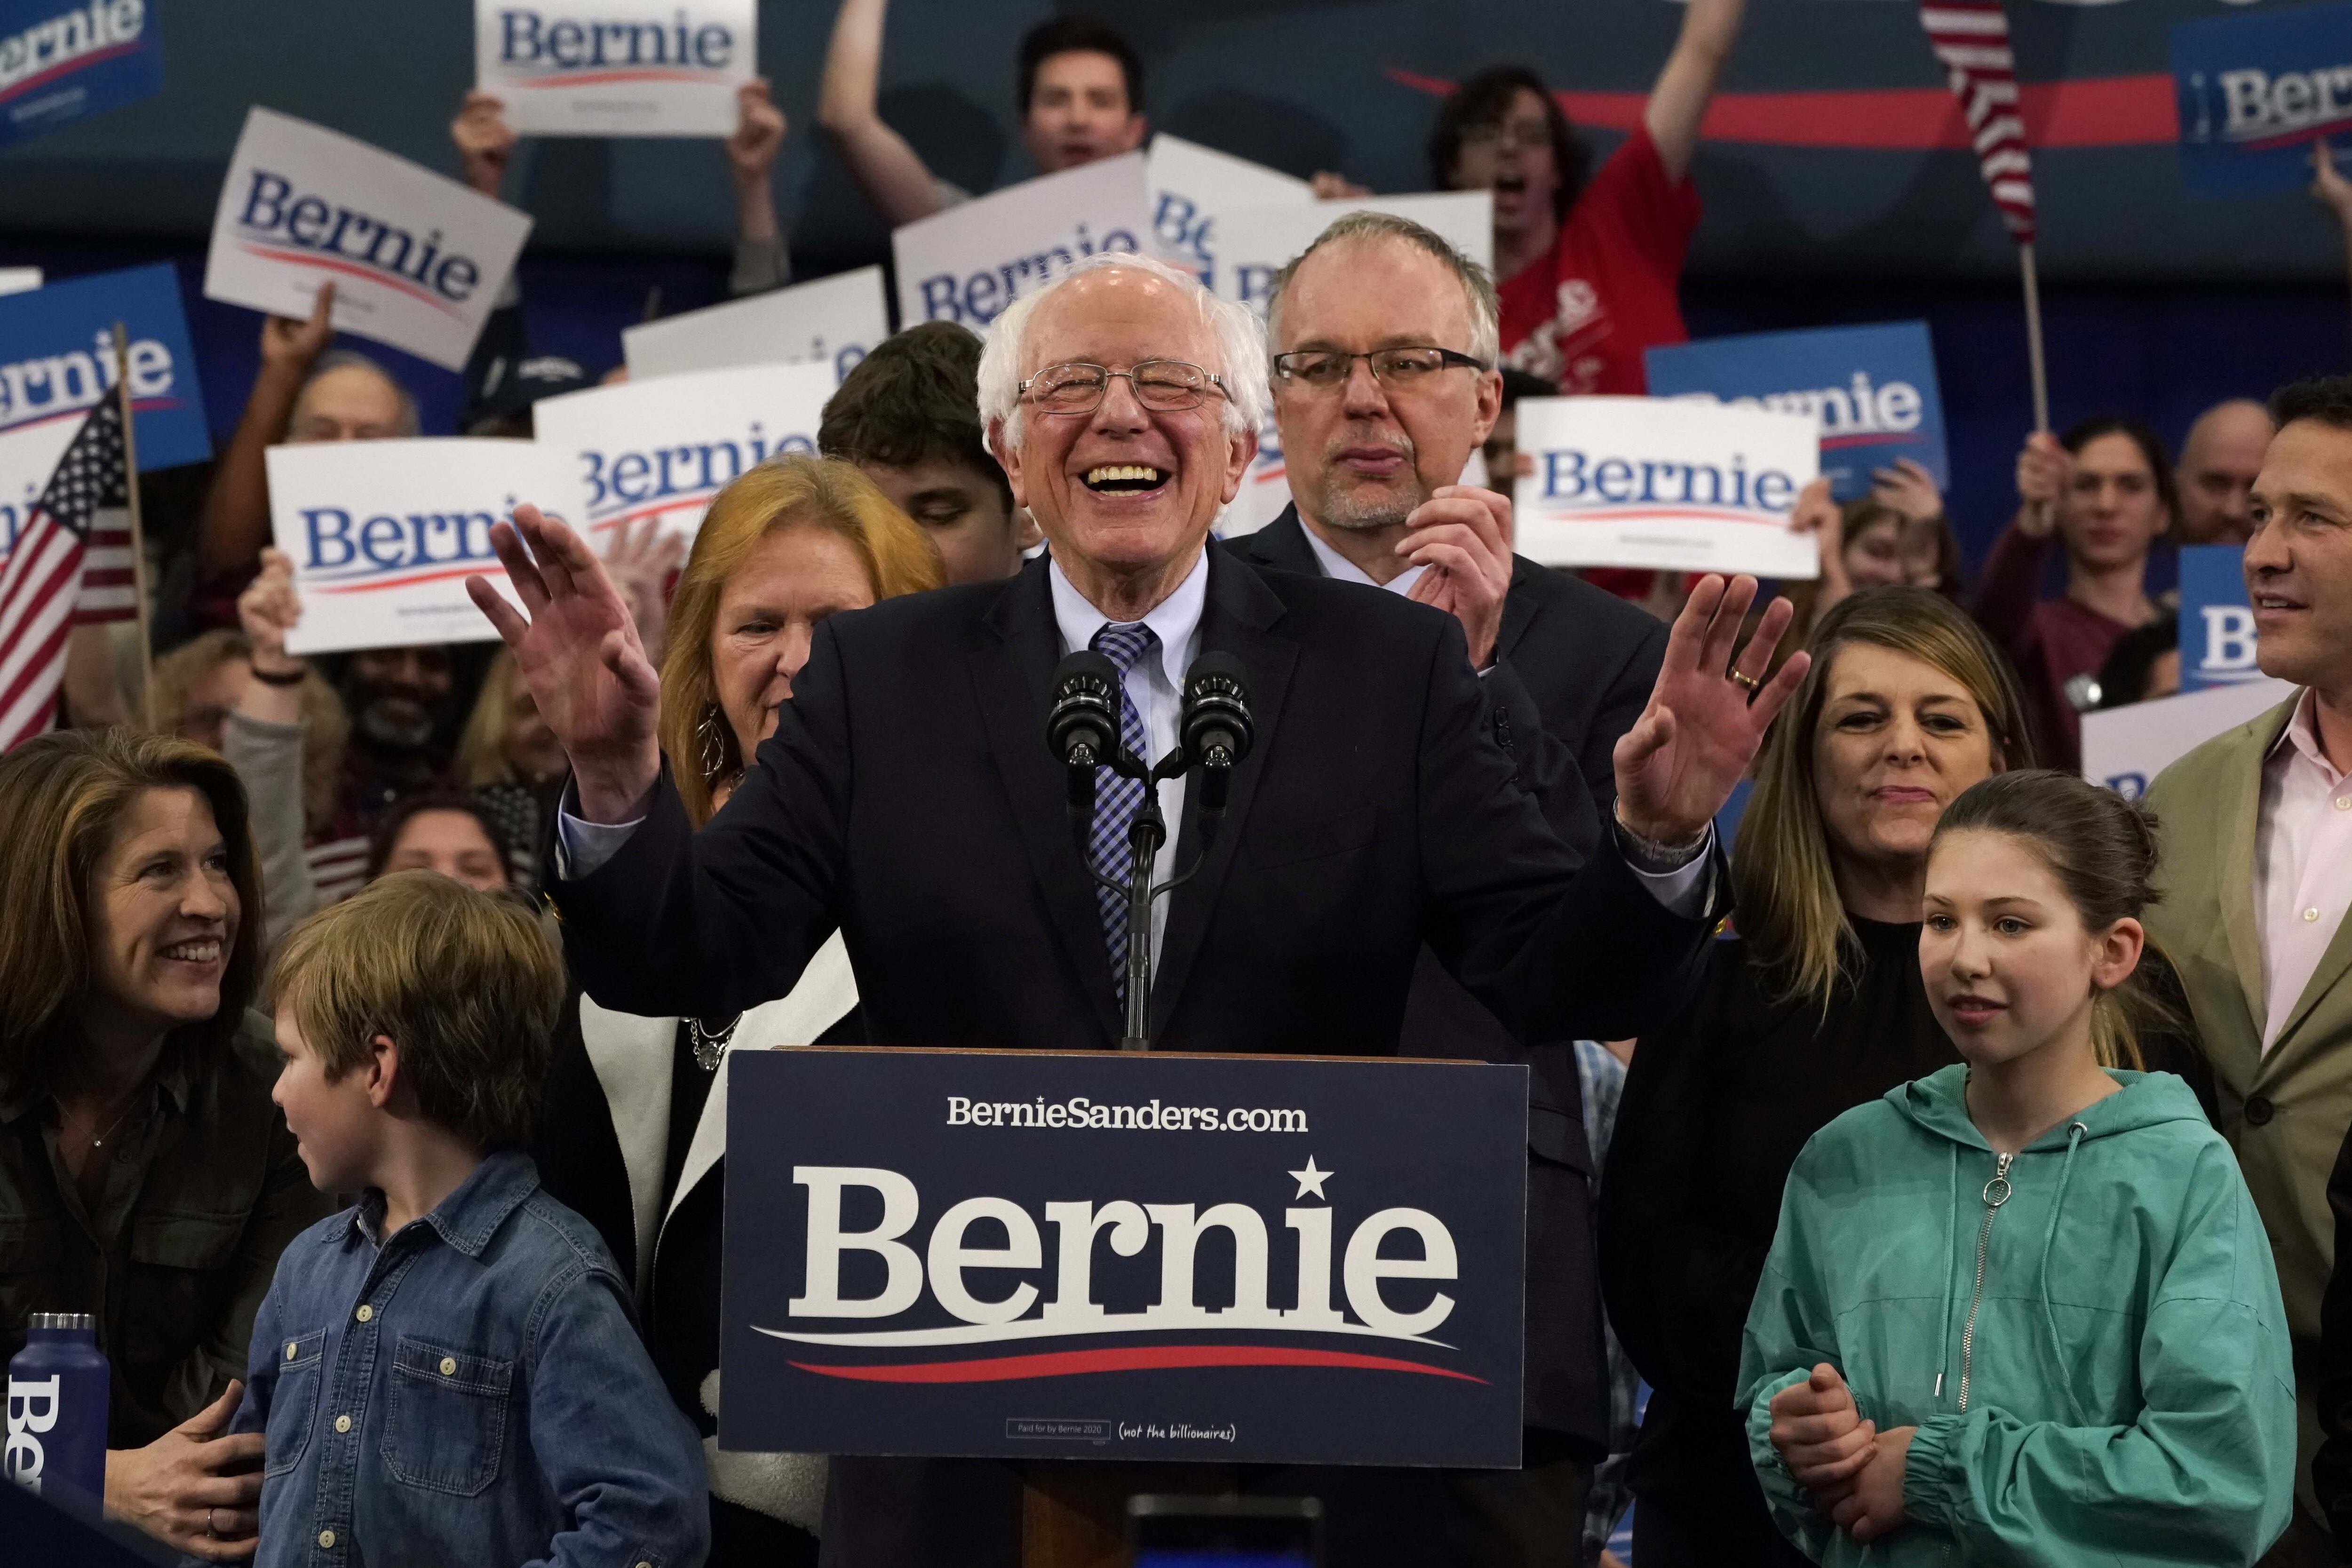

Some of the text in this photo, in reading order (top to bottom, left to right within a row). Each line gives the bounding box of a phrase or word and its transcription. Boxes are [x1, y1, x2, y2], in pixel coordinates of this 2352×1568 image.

[500, 9, 734, 69] Bernie
[239, 167, 480, 302] Bernie
[0, 330, 174, 418] rnie
[1542, 447, 1796, 513] Bernie
[299, 495, 567, 570] Bern
[946, 1095, 1308, 1132] BernieSanders.com
[788, 1154, 1459, 1337] Bernie
[1018, 1423, 1102, 1434] Paid for by Bernie 2020
[1119, 1421, 1236, 1442] (not the billionaires)
